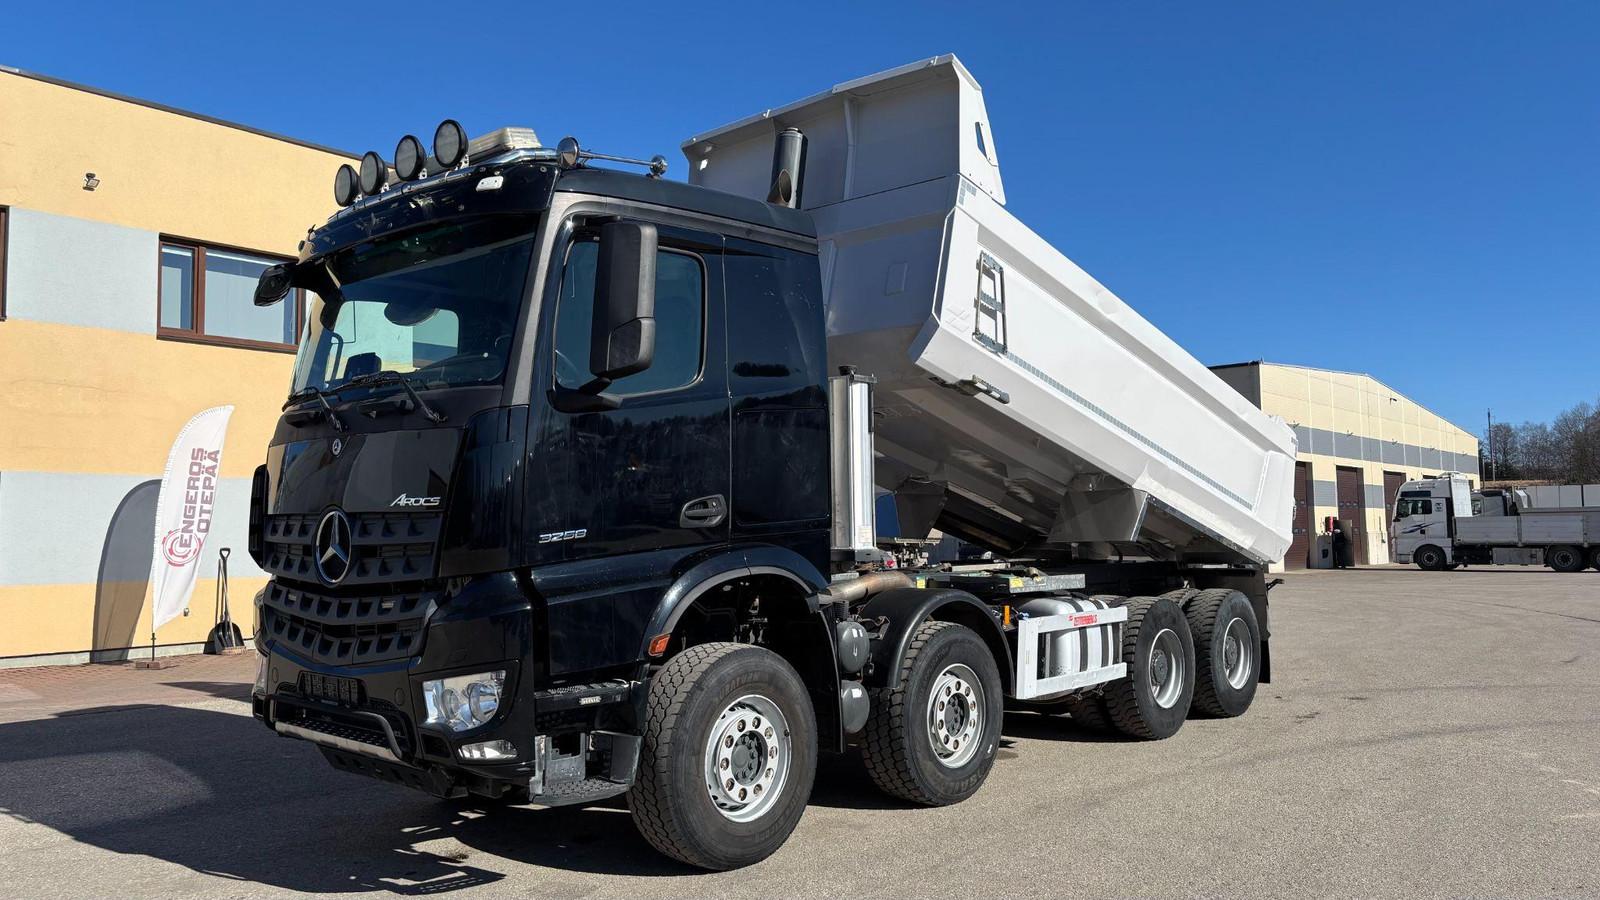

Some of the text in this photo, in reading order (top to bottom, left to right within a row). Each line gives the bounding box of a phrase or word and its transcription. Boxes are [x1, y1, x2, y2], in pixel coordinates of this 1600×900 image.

[179, 448, 204, 548] ENGEROS
[197, 449, 220, 533] OTEPÄÄ
[390, 493, 441, 507] AROCS
